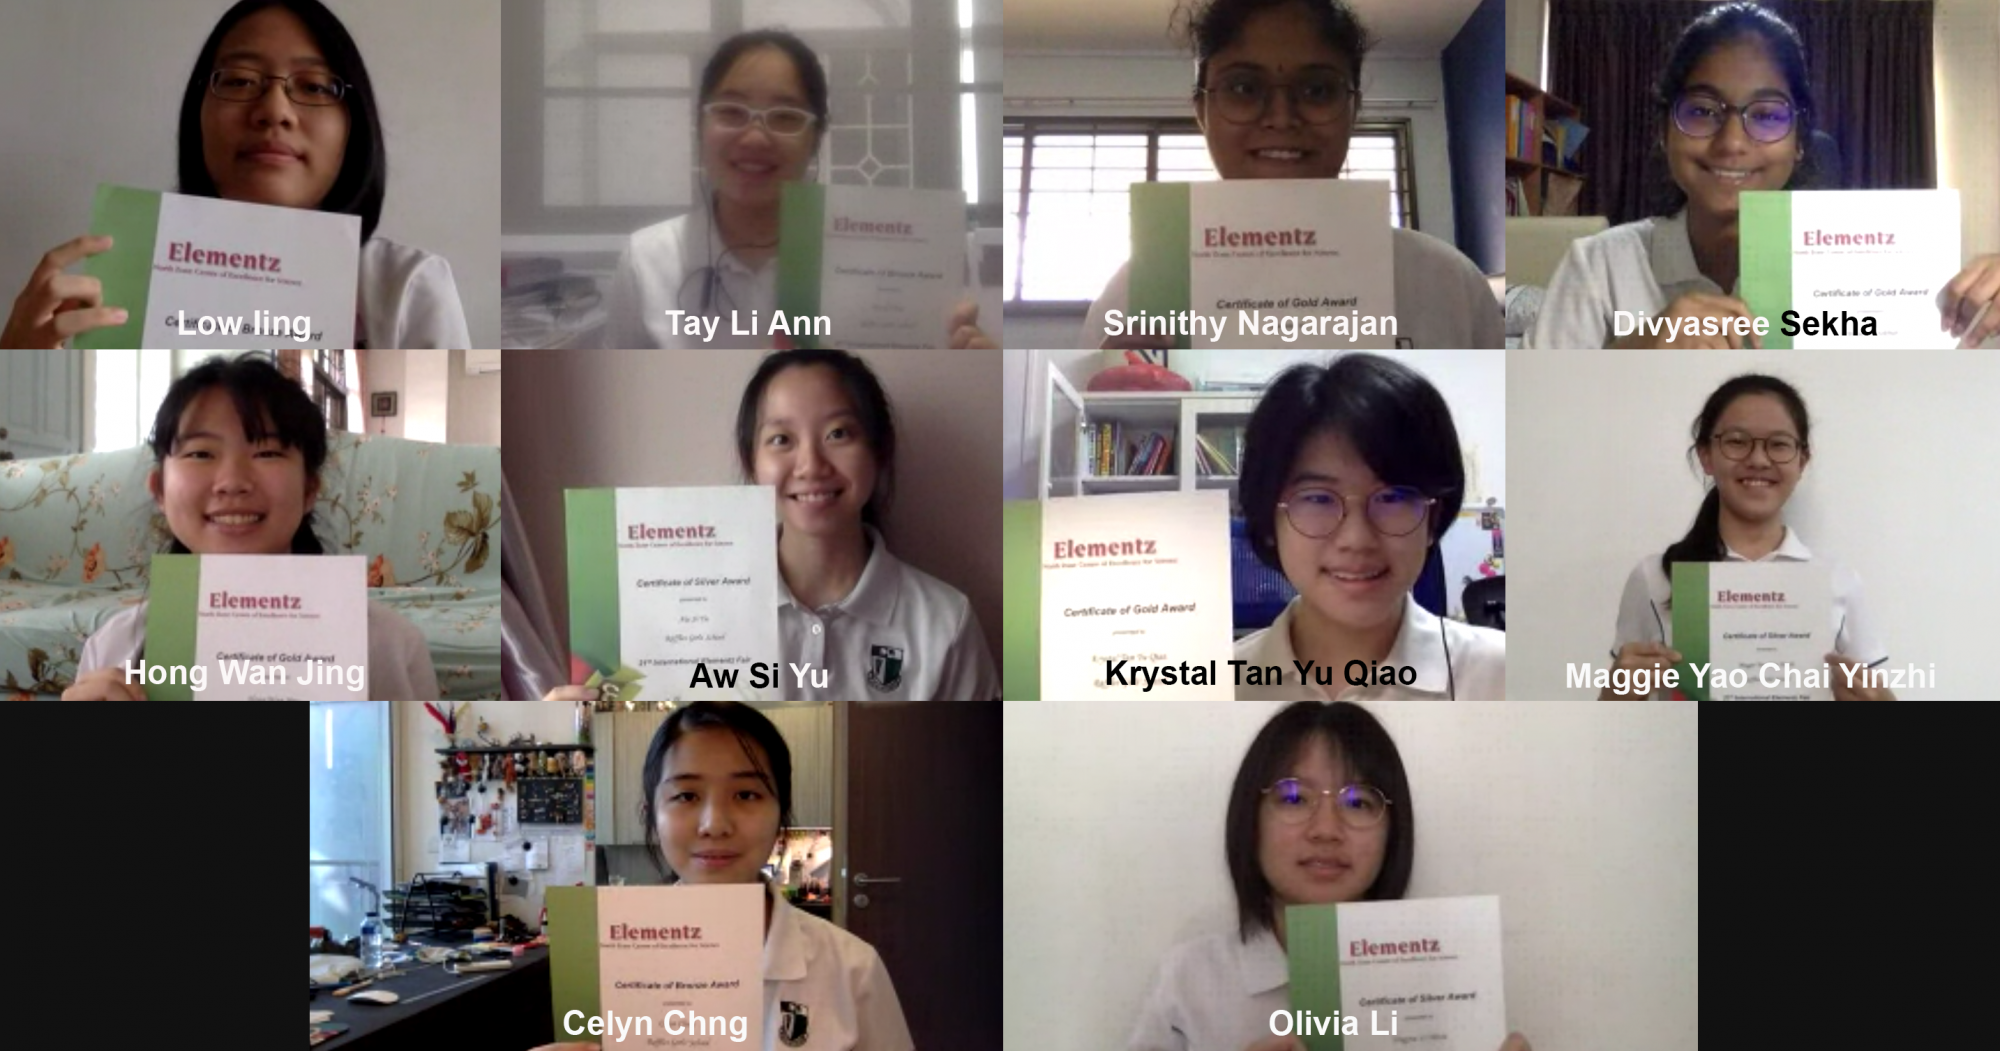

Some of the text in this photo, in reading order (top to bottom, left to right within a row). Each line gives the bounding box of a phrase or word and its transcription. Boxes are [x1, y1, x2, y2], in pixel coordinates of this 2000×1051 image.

[833, 216, 914, 236] Elementz
[1204, 226, 1317, 248] Elementz
[1803, 229, 1896, 246] Elementz
[168, 241, 281, 273] Elementz
[1216, 297, 1358, 310] Certificate of Gold Award
[628, 524, 717, 540] Elementz
[1054, 538, 1157, 560] Elementz
[209, 590, 302, 610] Elementz
[1717, 589, 1786, 602] Elementz
[1063, 602, 1196, 617] Certificate of Gold Award
[610, 923, 703, 940] Elementz
[1350, 938, 1441, 957] Elementz
